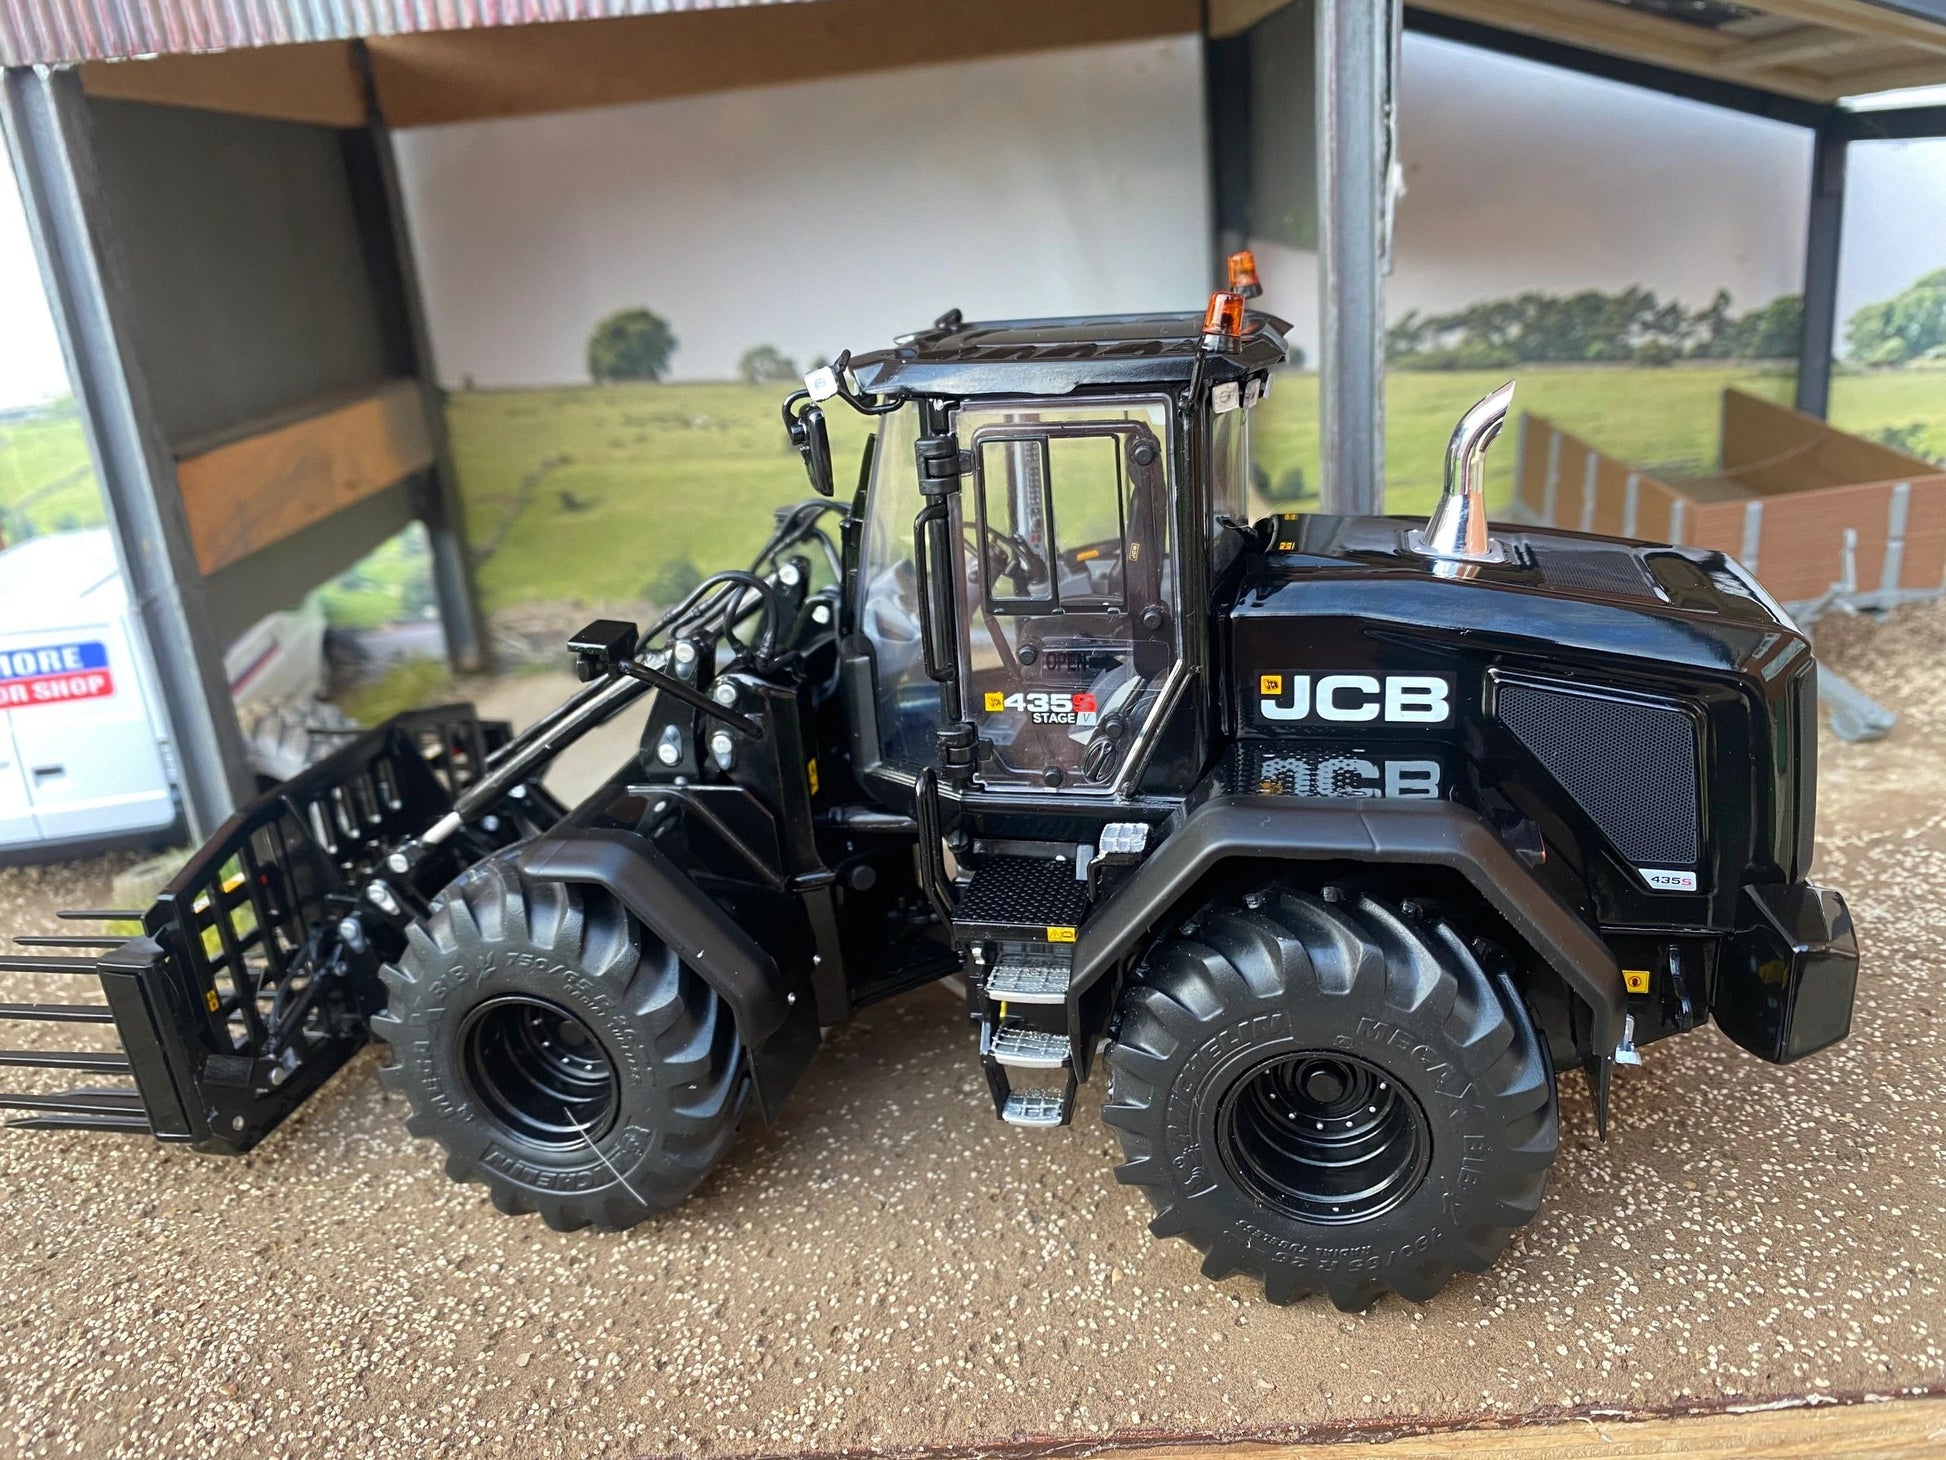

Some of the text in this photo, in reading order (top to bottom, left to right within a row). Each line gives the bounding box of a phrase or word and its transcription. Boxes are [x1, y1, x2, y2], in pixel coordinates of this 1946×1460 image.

[32, 675, 105, 700] SHOP
[1003, 692, 1098, 713] 435S
[1261, 675, 1450, 722] JCB
[1032, 712, 1093, 724] STAGE V
[1650, 875, 1693, 887] 435S
